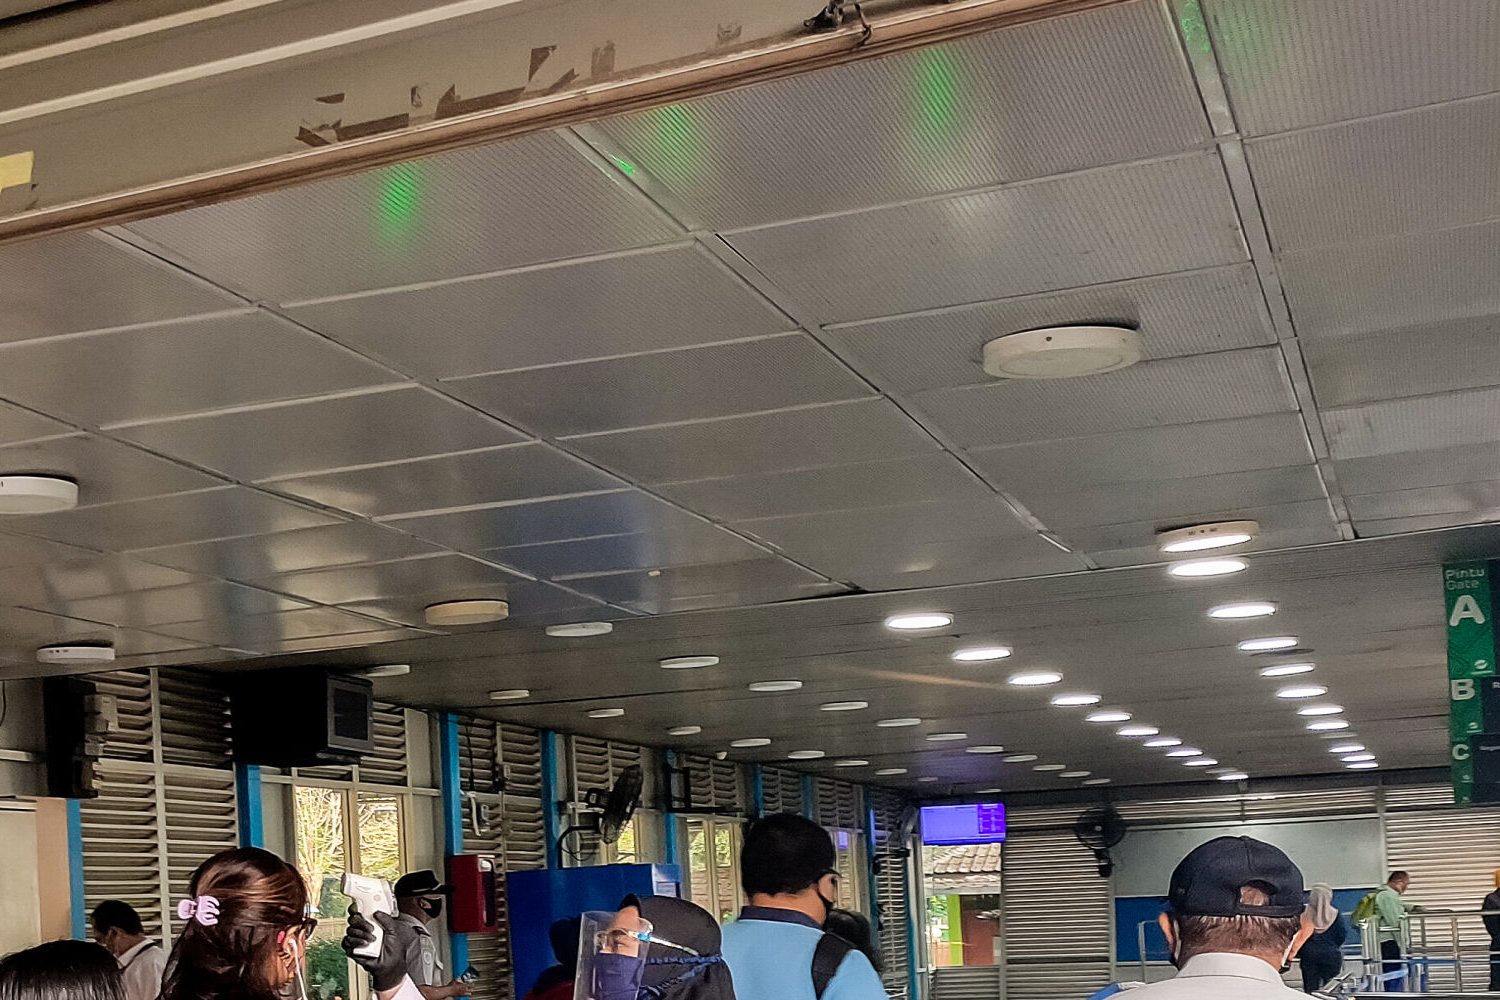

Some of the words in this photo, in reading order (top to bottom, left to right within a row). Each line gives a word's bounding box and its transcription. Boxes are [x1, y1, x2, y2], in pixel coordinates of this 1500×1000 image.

[1445, 568, 1485, 580] Pintu
[1446, 579, 1481, 590] Gate
[1449, 594, 1486, 627] A
[1451, 678, 1476, 701] B
[1451, 743, 1470, 760] C
